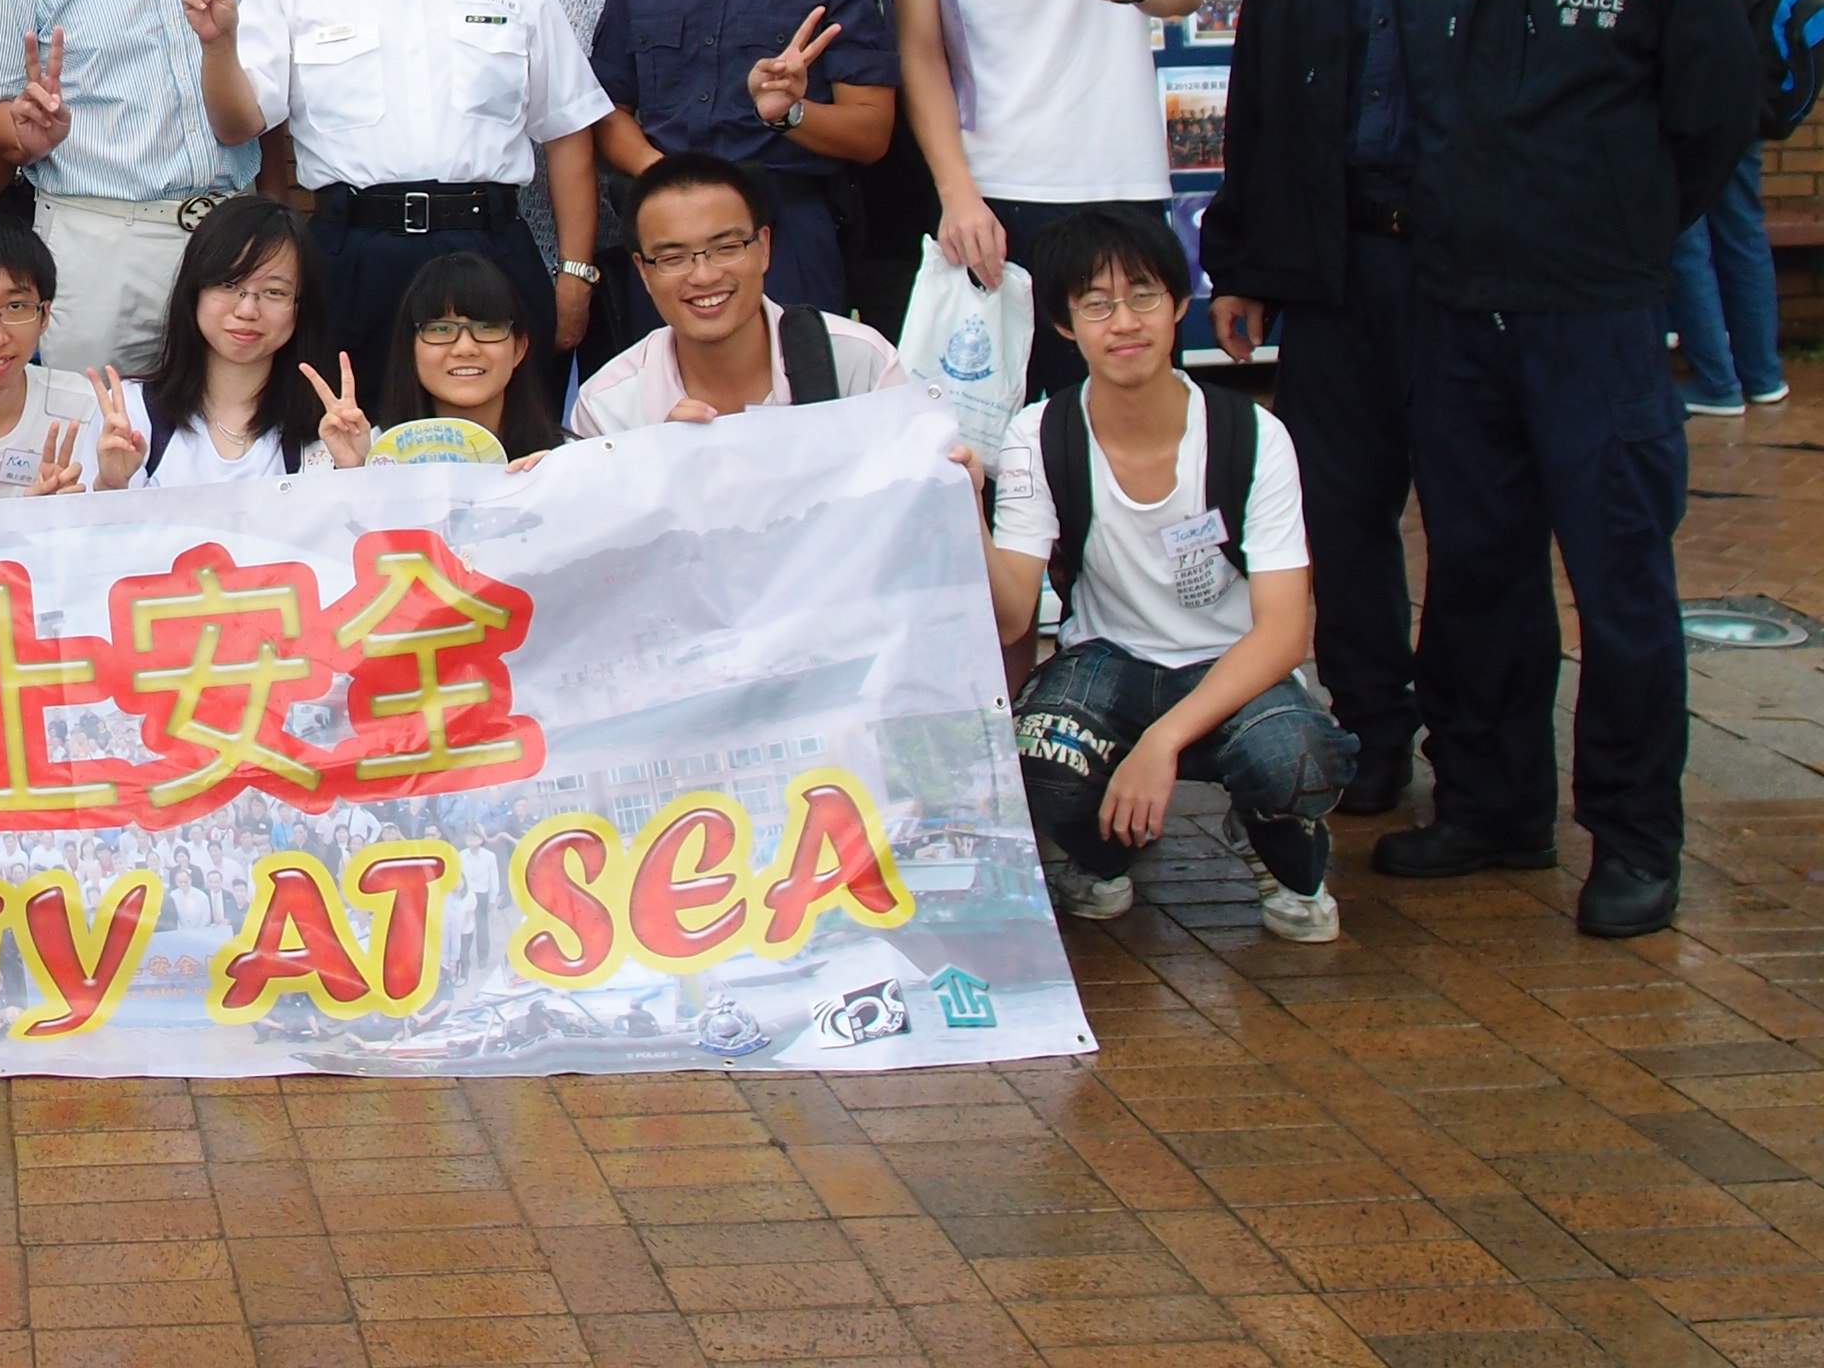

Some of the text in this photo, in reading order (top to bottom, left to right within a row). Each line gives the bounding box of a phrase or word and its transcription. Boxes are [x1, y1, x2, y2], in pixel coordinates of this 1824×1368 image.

[1177, 577, 1216, 594] BECAUSE
[1184, 589, 1212, 601] KNOW
[204, 838, 466, 1023] AT
[508, 764, 916, 989] SEA
